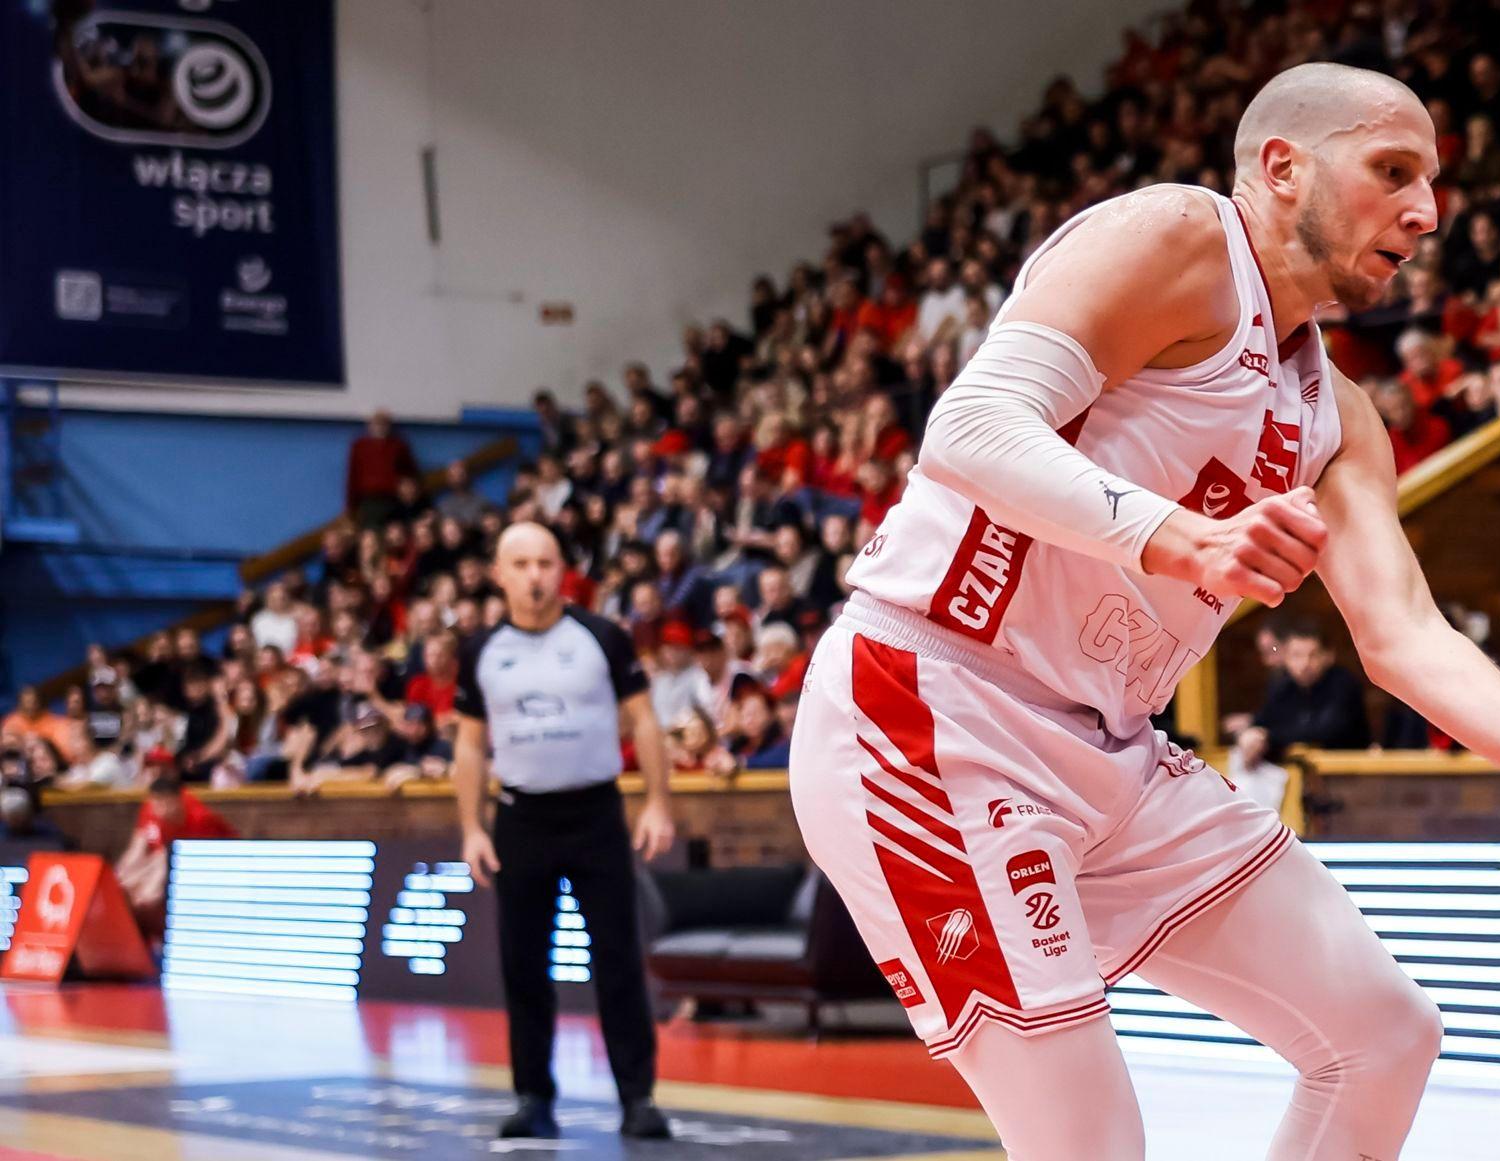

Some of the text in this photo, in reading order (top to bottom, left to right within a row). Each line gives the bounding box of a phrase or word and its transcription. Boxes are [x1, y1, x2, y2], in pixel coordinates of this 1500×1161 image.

[174, 197, 274, 238] sport
[1010, 861, 1050, 880] ORLEN
[1032, 930, 1071, 949] Basket
[1043, 944, 1068, 958] Liga
